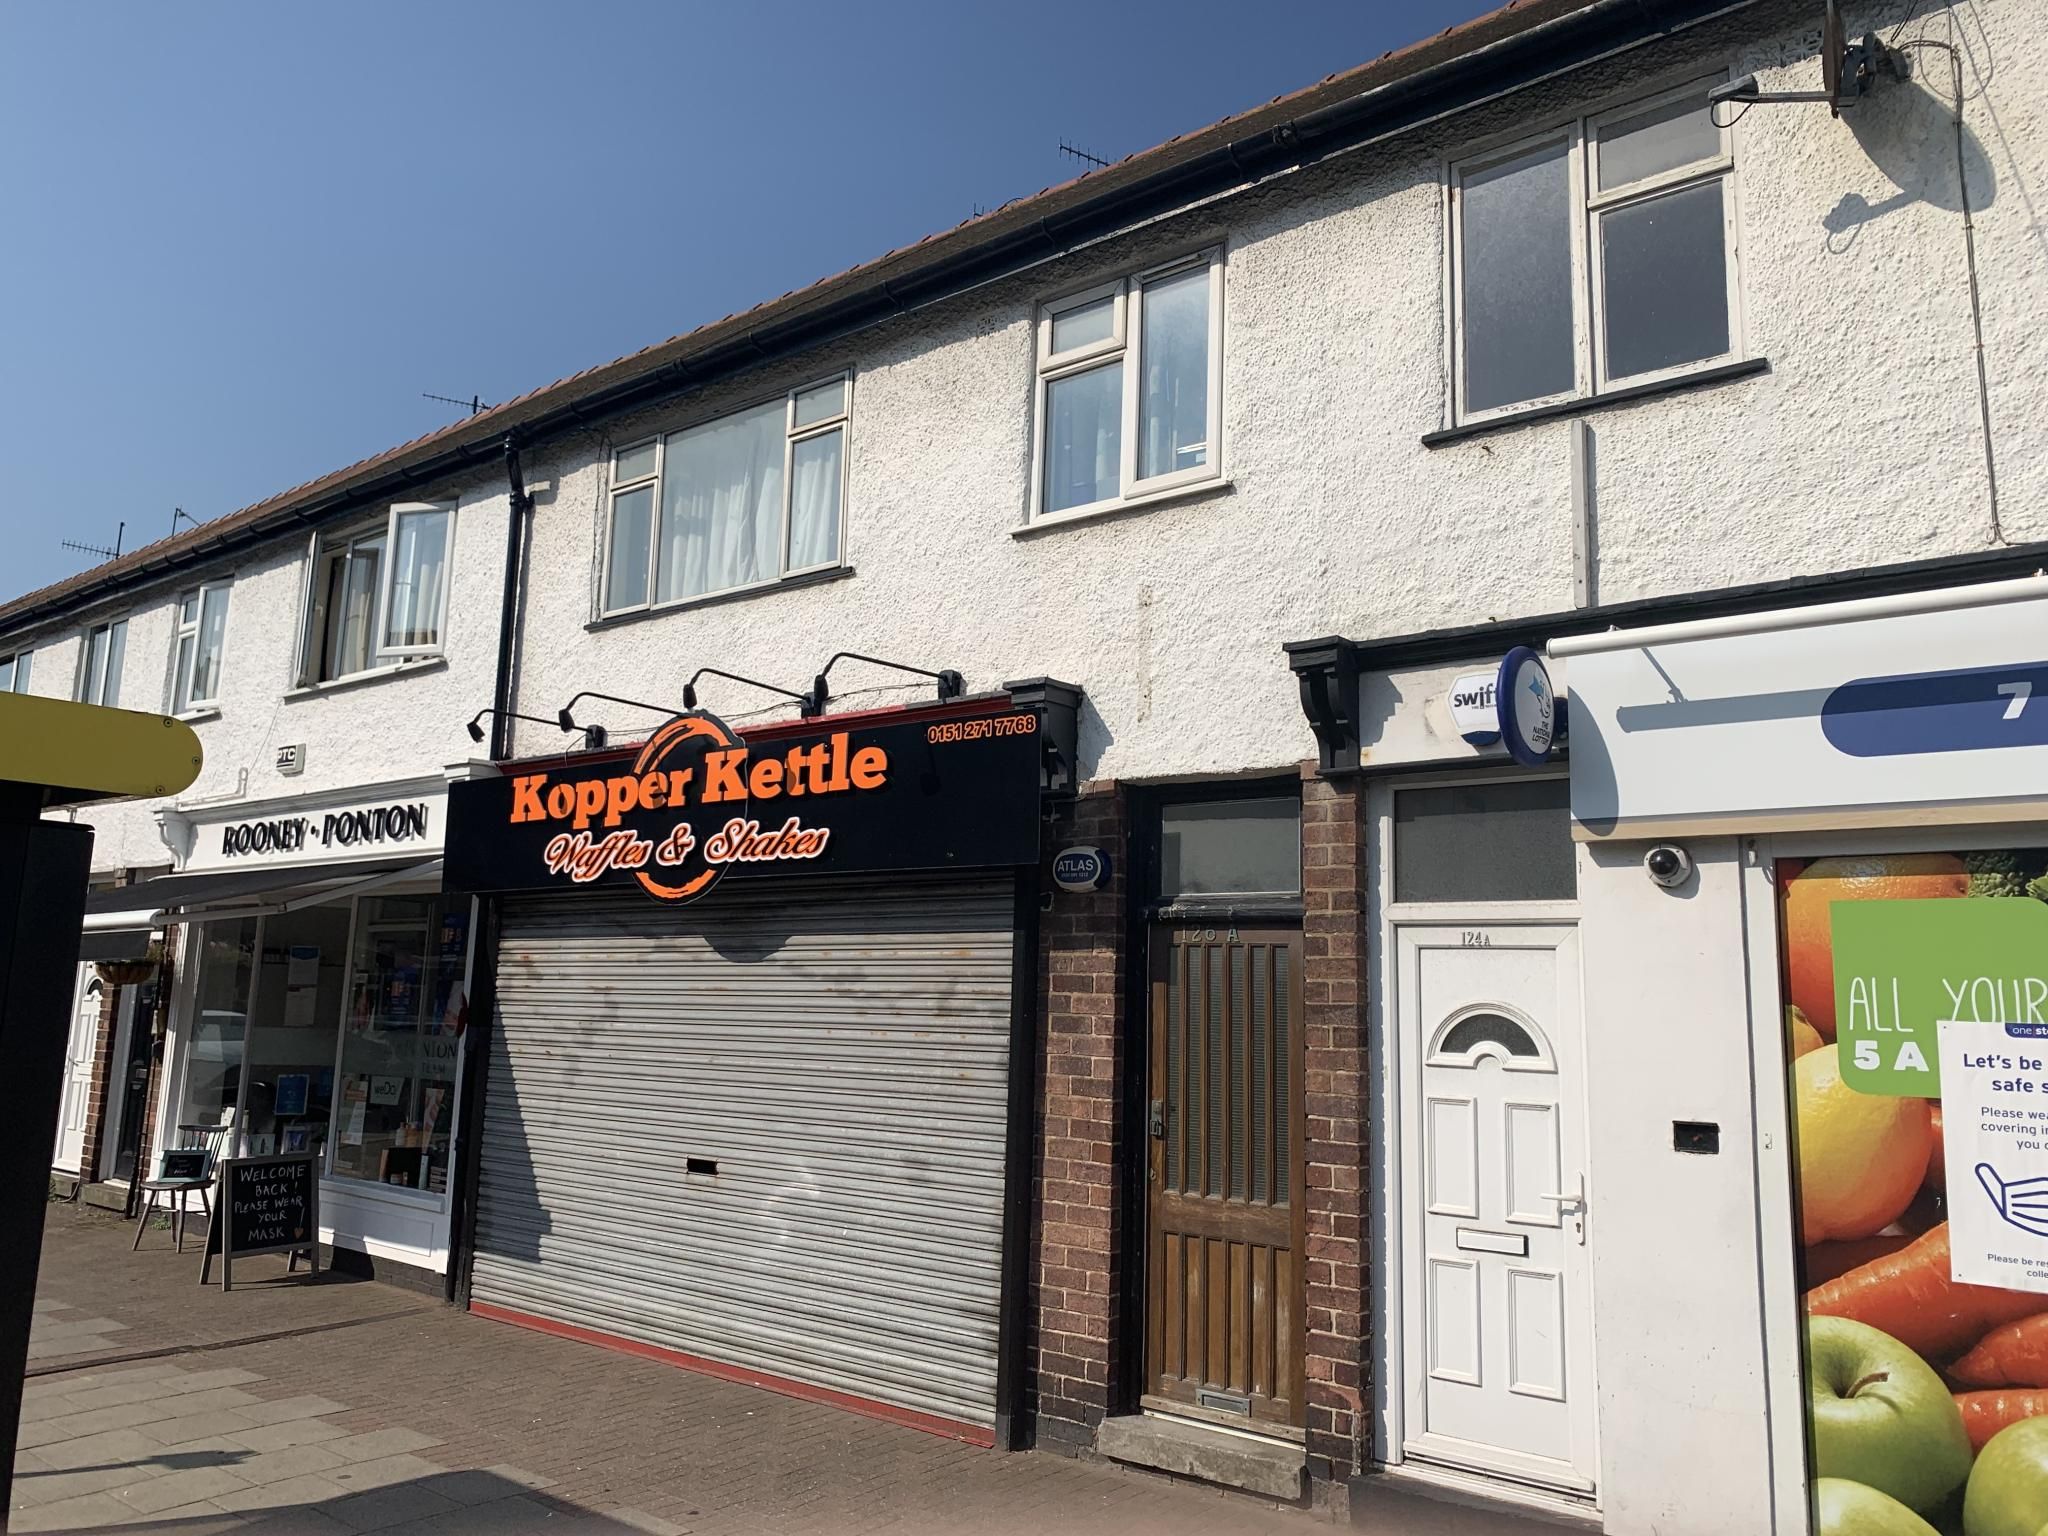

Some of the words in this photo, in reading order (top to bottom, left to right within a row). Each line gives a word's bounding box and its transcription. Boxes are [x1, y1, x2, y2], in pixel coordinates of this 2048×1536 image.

[1453, 682, 1497, 709] swif
[927, 723, 962, 743] 0151
[964, 720, 992, 739] 271
[995, 715, 1036, 736] 7768
[510, 768, 693, 829] Kopper
[702, 732, 888, 803] Kettle
[222, 817, 307, 855] ROONEY
[322, 803, 427, 845] PONTON
[544, 830, 652, 882] Waffles
[656, 823, 695, 866] &
[704, 817, 830, 864] Shakes
[1057, 859, 1094, 872] ATLAS
[1849, 977, 1914, 1032] ALL
[1942, 977, 2048, 1023] YOUR
[2012, 1027, 2032, 1035] one
[2035, 1026, 2048, 1035] st
[1853, 1040, 1880, 1071] 5
[1963, 1053, 2012, 1069] Let's
[2019, 1055, 2043, 1071] be
[1991, 1077, 2034, 1093] safe
[1981, 1106, 2023, 1119] Please
[2027, 1110, 2048, 1120] we
[1981, 1123, 2037, 1136] covering
[2016, 1140, 2040, 1150] you
[241, 1164, 306, 1182] WELCOME
[234, 1200, 268, 1214] PLEASE
[274, 1196, 303, 1208] WEAR
[258, 1210, 287, 1224] YOUR
[248, 1227, 285, 1242] MASK
[1987, 1253, 2019, 1264] Please
[2021, 1257, 2033, 1266] be
